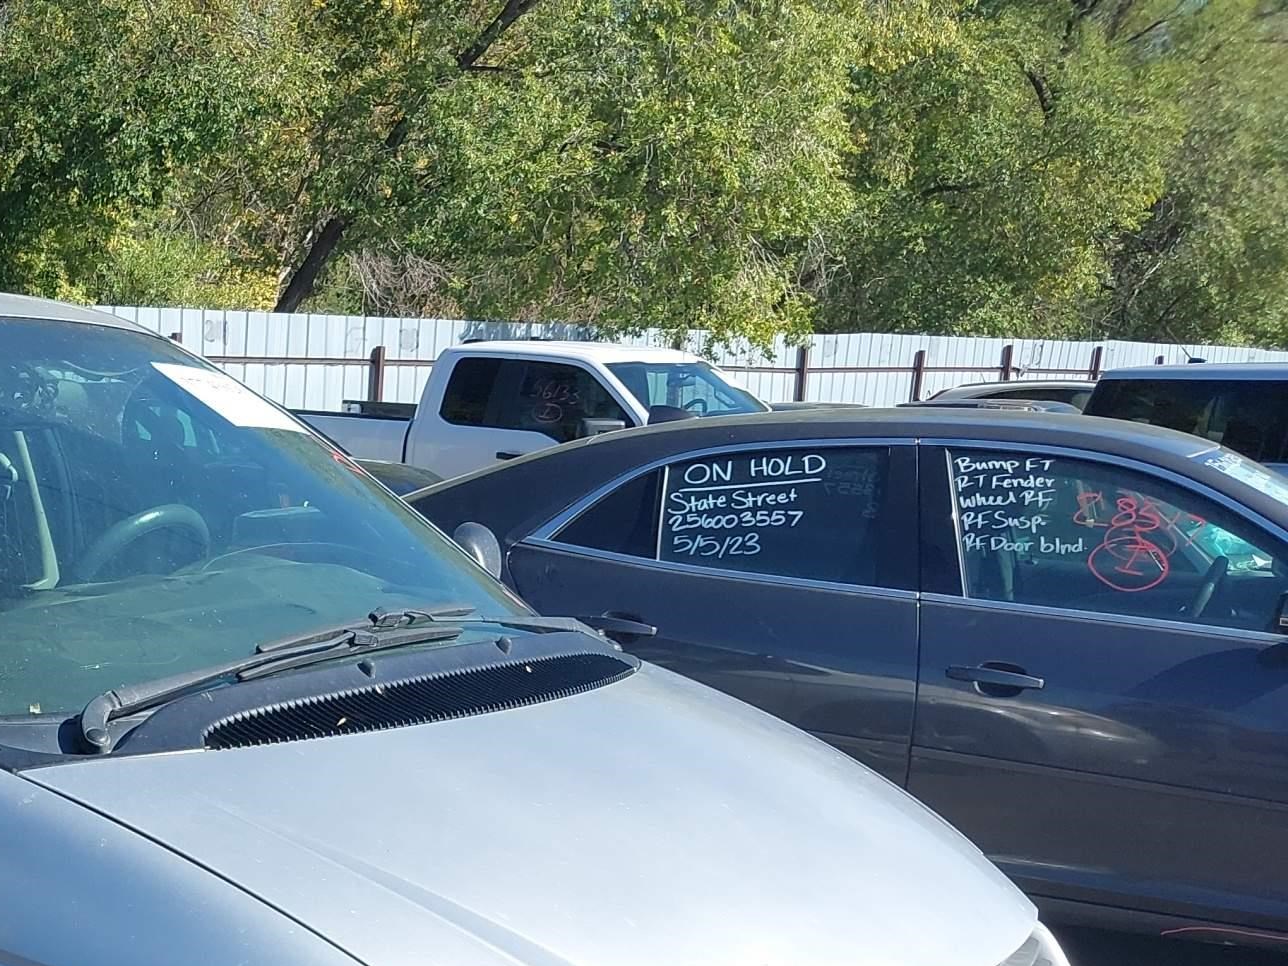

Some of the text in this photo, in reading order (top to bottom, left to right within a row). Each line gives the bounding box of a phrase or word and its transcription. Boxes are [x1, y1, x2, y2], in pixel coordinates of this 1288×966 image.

[684, 461, 732, 484] ON
[750, 455, 826, 477] HOLD
[954, 457, 1055, 473] Bump FT
[955, 474, 1055, 492] RT Fender
[667, 492, 727, 514] State
[731, 488, 798, 509] Street
[1019, 489, 1056, 508] RF
[668, 510, 803, 531] 256003557
[961, 510, 992, 530] RF
[673, 532, 761, 558] 5/5/23
[963, 533, 990, 552] RF
[990, 536, 1034, 551] Door
